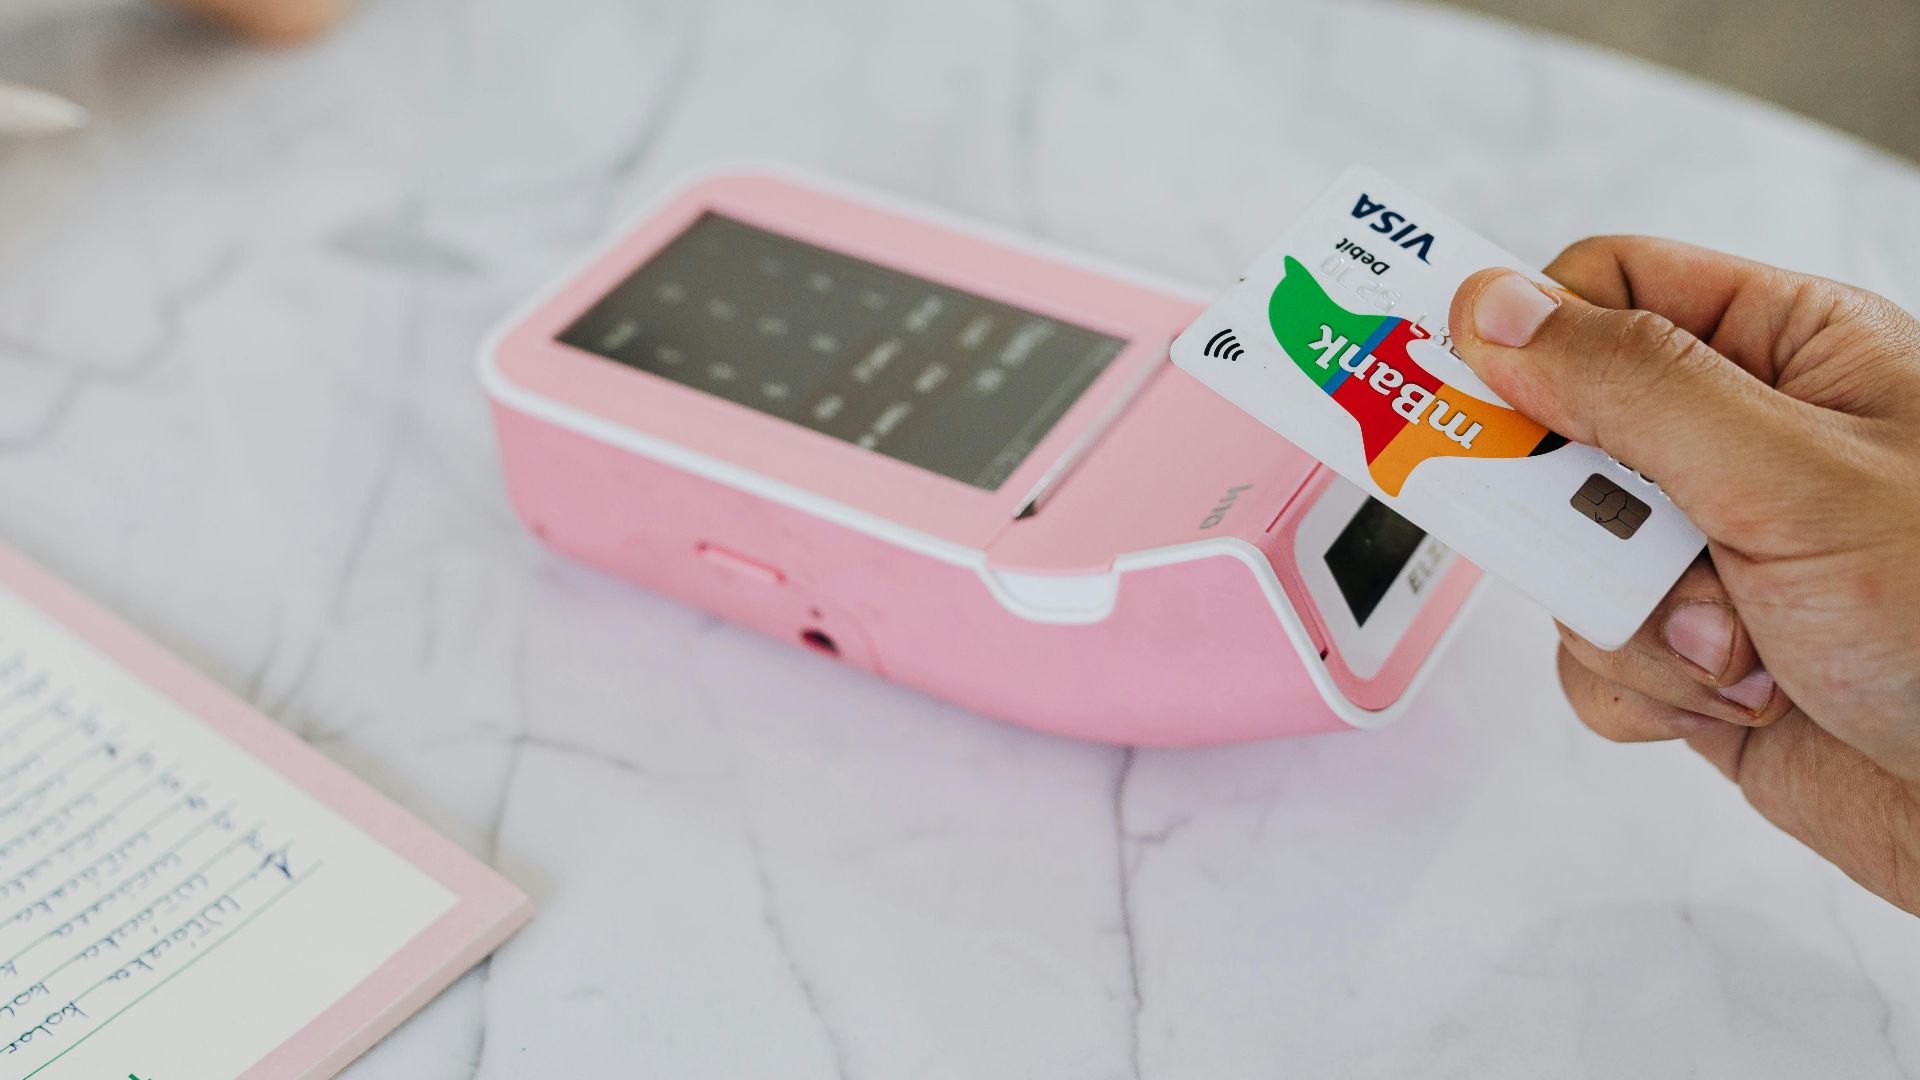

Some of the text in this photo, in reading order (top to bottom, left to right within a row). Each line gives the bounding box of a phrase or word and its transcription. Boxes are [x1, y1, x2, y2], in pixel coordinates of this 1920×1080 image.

[1335, 237, 1390, 276] Debit
[1351, 193, 1435, 265] VISA
[1307, 322, 1484, 450] mBank
